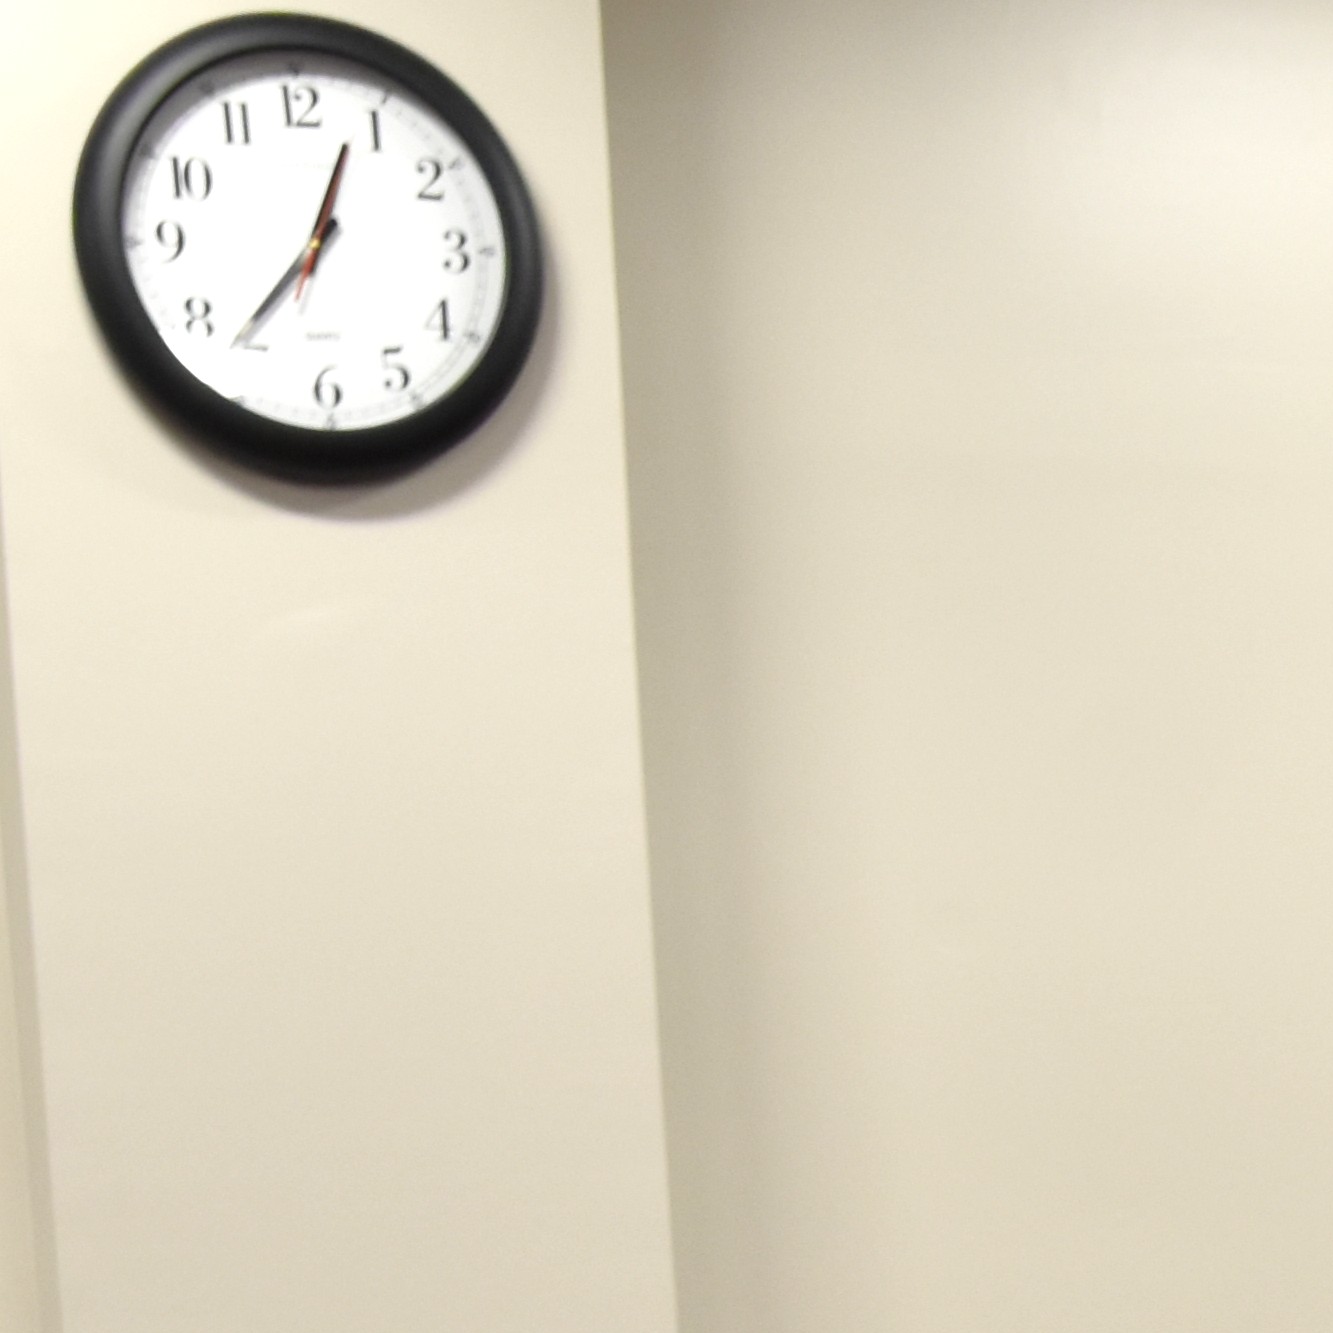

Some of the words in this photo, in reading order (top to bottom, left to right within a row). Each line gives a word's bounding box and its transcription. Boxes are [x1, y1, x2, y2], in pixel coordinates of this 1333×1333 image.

[220, 100, 251, 146] 11
[279, 82, 322, 129] 12
[367, 108, 382, 153] 1
[170, 154, 213, 201] 10
[414, 158, 445, 202] 2
[154, 219, 187, 264] 9
[441, 228, 472, 275] 3
[183, 296, 215, 338] 8
[424, 297, 454, 343] 4
[312, 364, 344, 409] 6
[380, 345, 412, 392] 5
